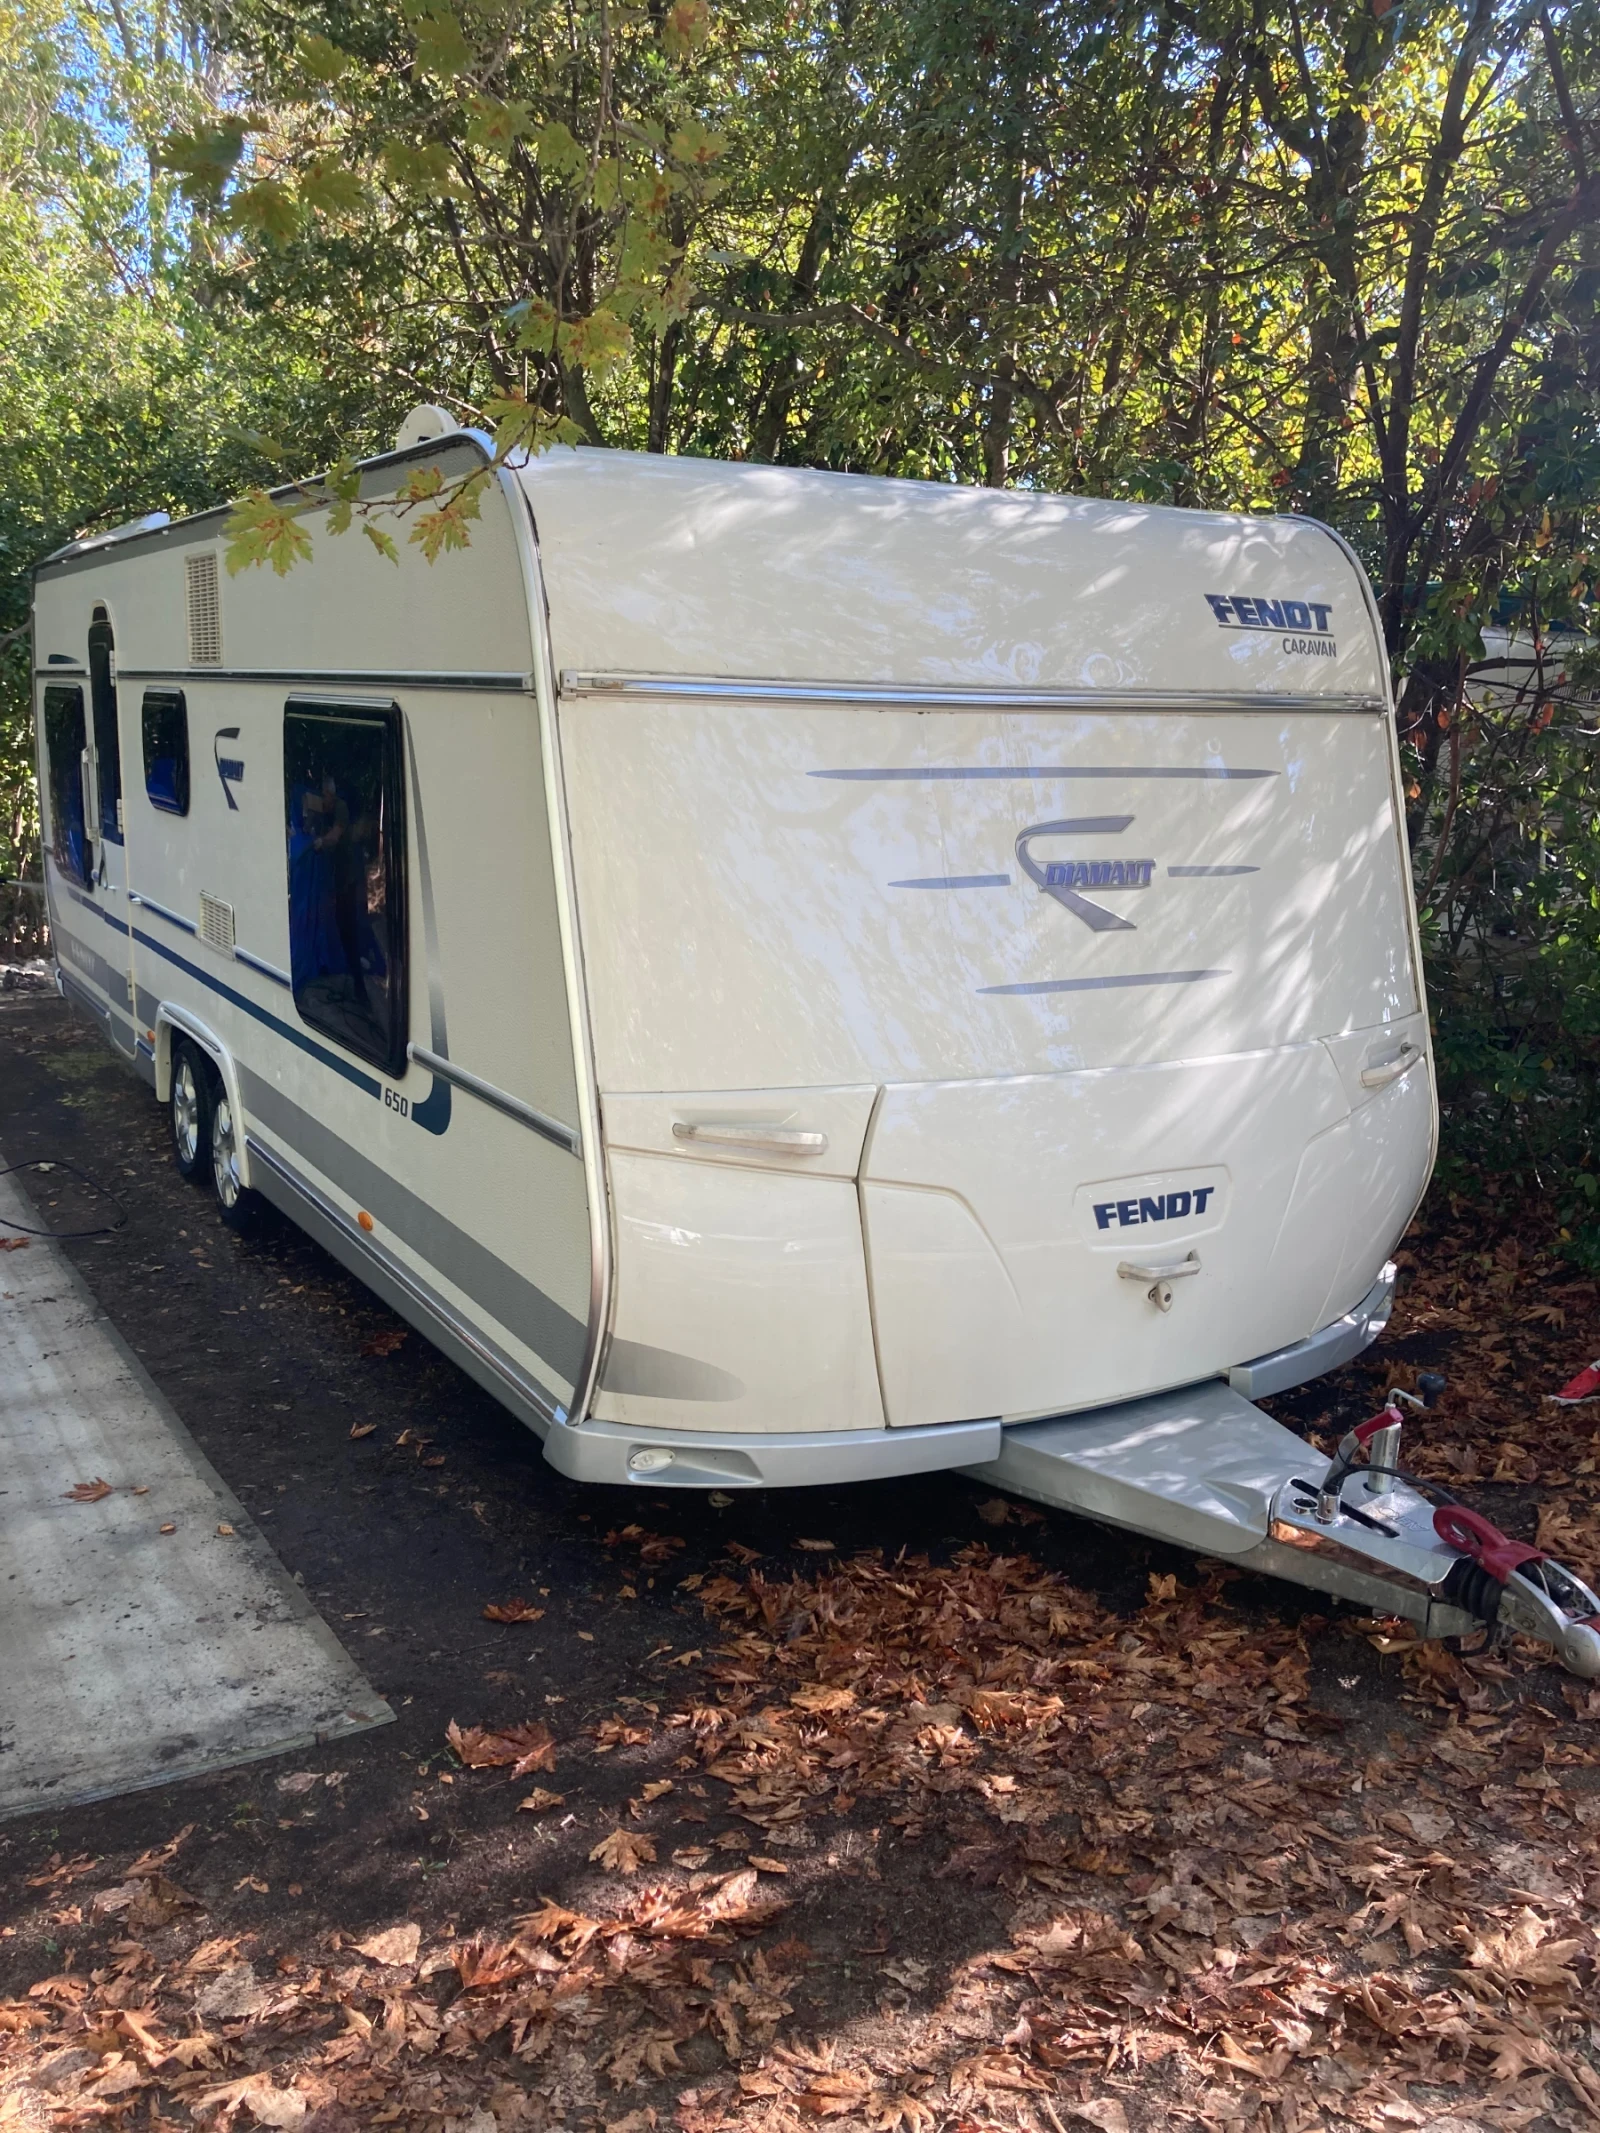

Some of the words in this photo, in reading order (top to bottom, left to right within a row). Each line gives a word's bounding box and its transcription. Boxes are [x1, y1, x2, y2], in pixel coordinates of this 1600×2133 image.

[1204, 593, 1333, 631] FENDT
[1282, 638, 1337, 657] CARAVAN
[1046, 860, 1156, 886] DIAMANT
[384, 1087, 409, 1118] 650
[1092, 1186, 1214, 1230] FENDT
